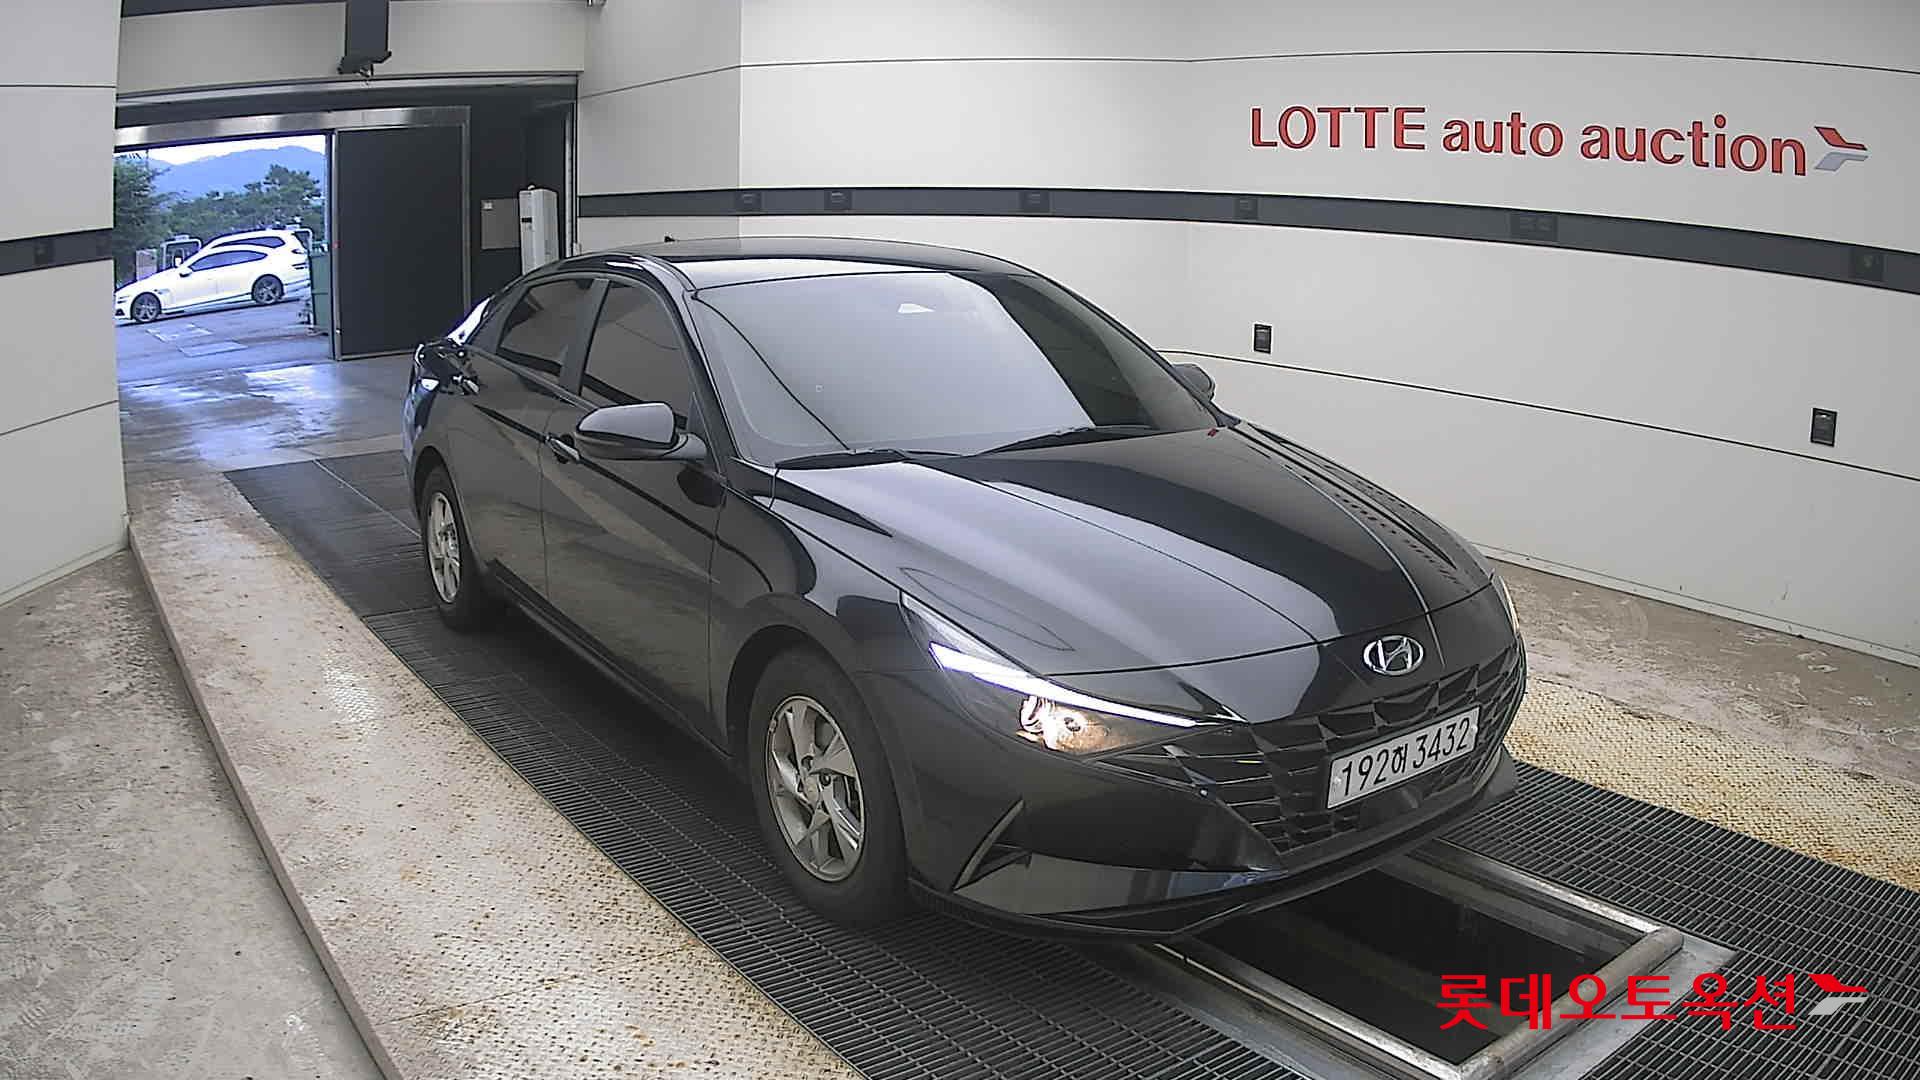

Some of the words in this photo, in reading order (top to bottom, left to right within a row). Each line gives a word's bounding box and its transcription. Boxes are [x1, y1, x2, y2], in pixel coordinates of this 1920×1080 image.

[1251, 106, 1426, 150] LOTTE
[1442, 112, 1564, 157] auto
[1580, 114, 1807, 177] auction
[1413, 717, 1470, 768] 3432
